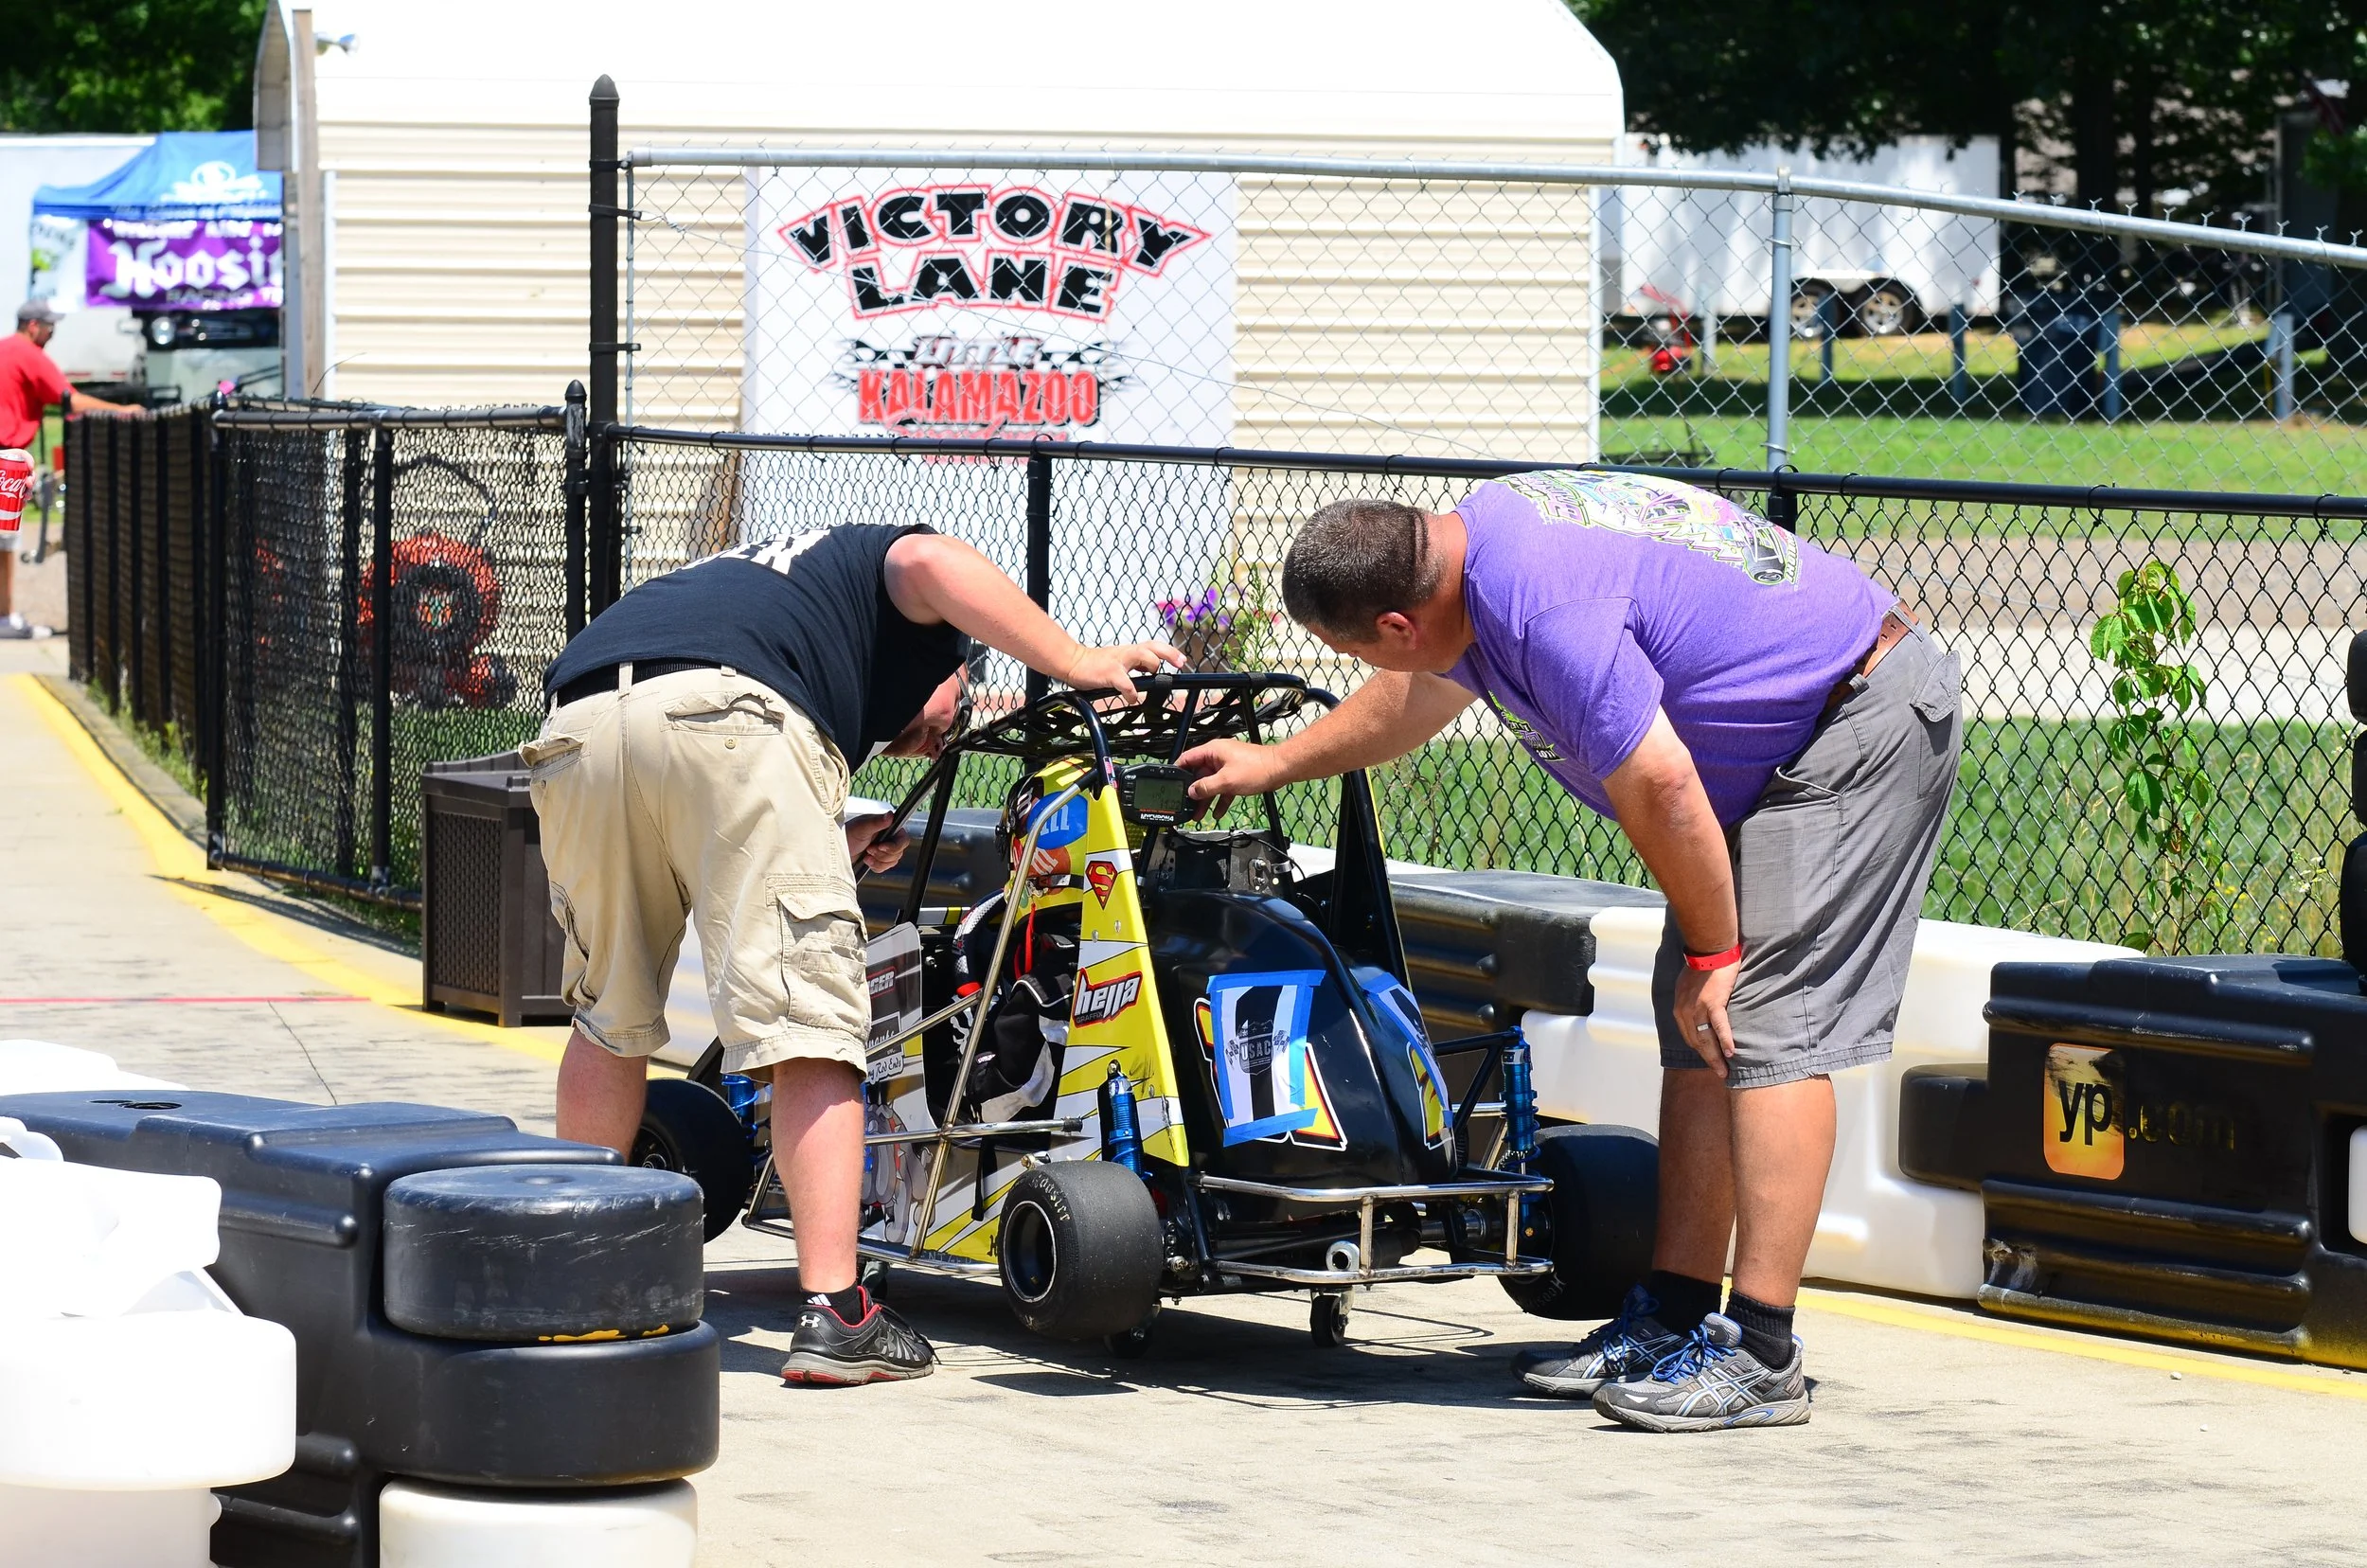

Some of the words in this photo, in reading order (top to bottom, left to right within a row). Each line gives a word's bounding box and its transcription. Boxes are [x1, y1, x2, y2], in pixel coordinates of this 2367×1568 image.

[783, 187, 1202, 271] VICTORY
[852, 256, 1115, 316] LANE
[913, 336, 1041, 365] LITTLE
[858, 368, 1101, 426] KALAMAZOO
[1074, 974, 1141, 1019] hella
[1076, 1010, 1103, 1024] GRAFFIX
[875, 1061, 887, 1076] Rod
[888, 1057, 901, 1071] Ends
[1241, 1040, 1271, 1060] USAC
